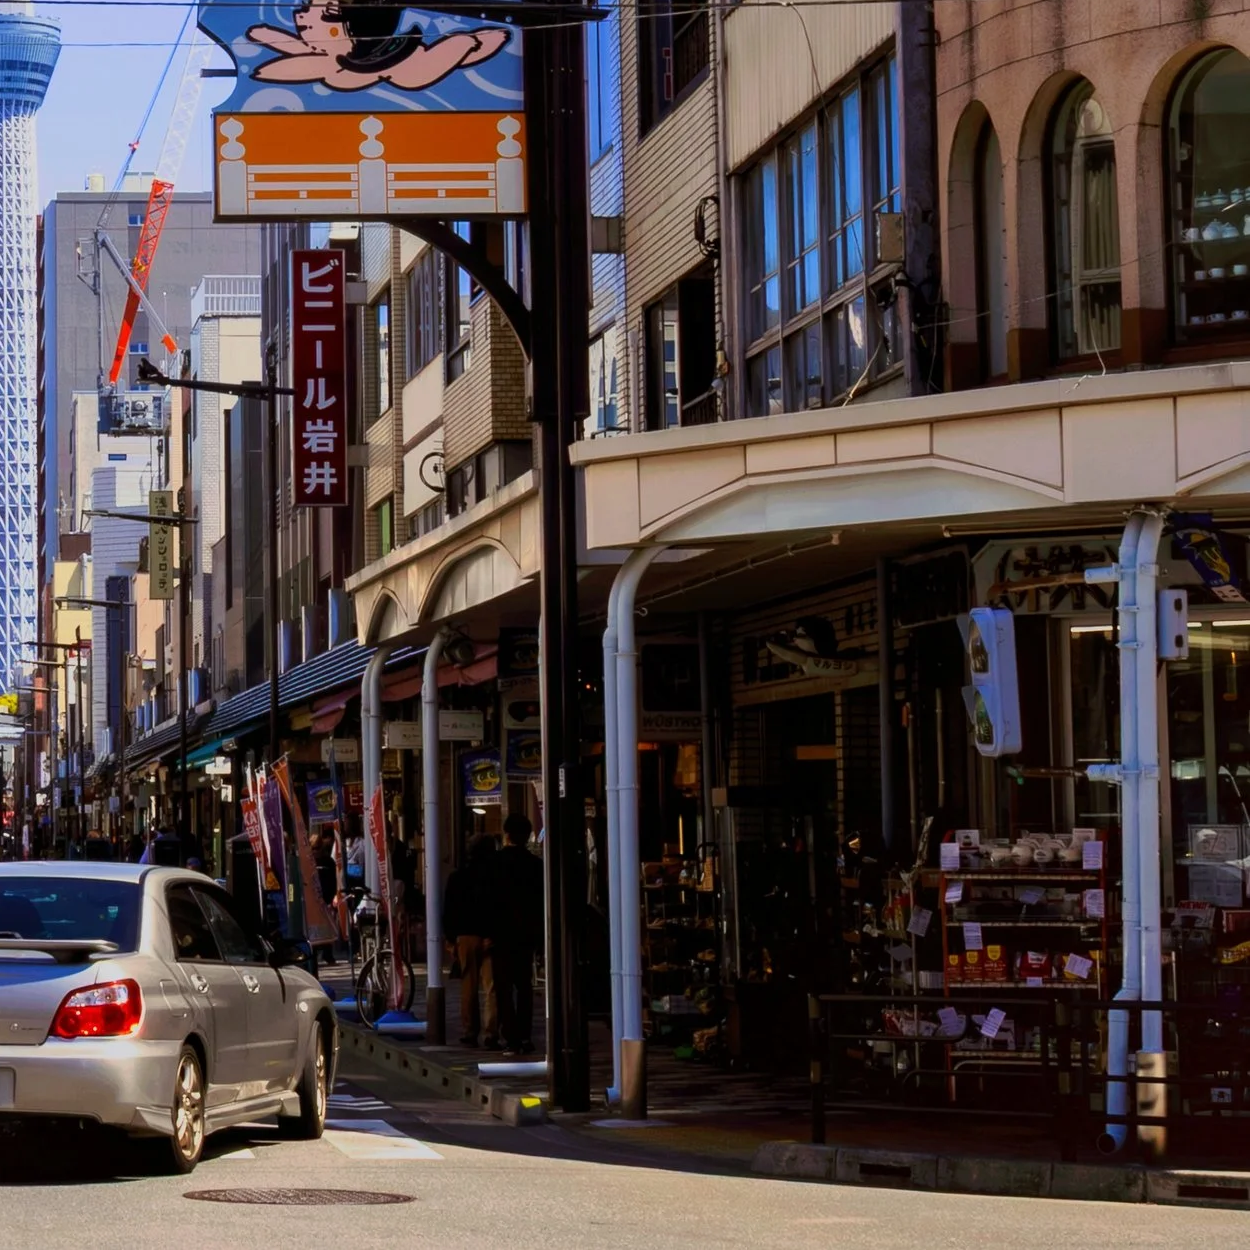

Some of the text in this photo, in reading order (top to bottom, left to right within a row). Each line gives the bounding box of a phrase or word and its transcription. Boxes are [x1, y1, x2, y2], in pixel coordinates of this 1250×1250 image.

[301, 258, 339, 496] ビニール岩井
